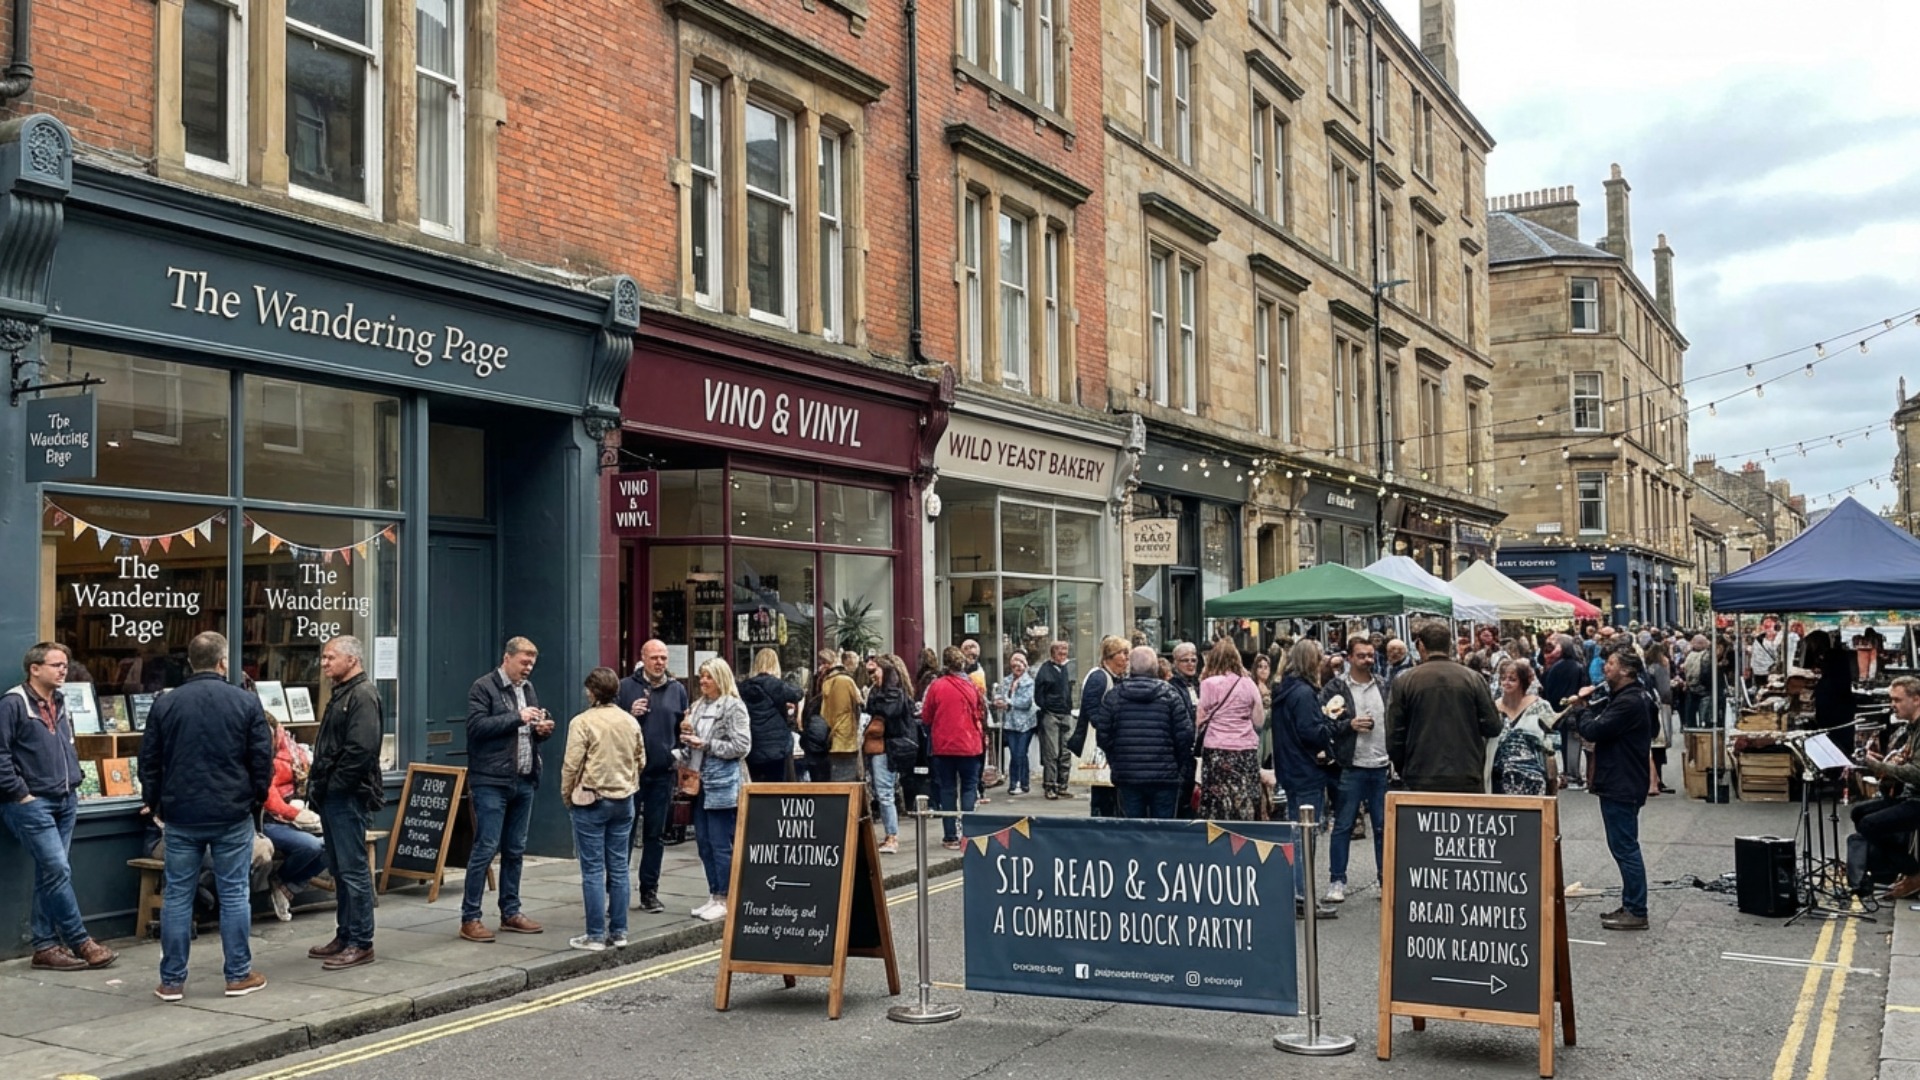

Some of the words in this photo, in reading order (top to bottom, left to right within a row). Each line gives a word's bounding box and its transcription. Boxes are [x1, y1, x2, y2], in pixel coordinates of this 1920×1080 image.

[167, 266, 241, 319] The
[253, 285, 436, 367] Wandering
[442, 326, 509, 378] Page
[704, 378, 765, 430] VINO
[771, 393, 790, 436] &
[799, 398, 862, 448] VINYL
[948, 431, 992, 463] WILD
[997, 442, 1046, 472] YEAST
[1048, 451, 1105, 483] BAKERY
[619, 479, 649, 496] VINO
[615, 511, 652, 527] VINYL
[114, 555, 160, 580] The
[299, 563, 338, 584] The
[72, 583, 200, 615] Wandering
[265, 588, 369, 617] Wandering
[109, 614, 164, 644] Page
[297, 616, 340, 643] Page
[781, 798, 815, 818] VINO
[1417, 811, 1461, 833] WILD
[1467, 813, 1517, 836] YEAST
[749, 844, 780, 864] WINE
[783, 845, 840, 867] TASTINGS
[1435, 836, 1497, 859] BAKERY
[996, 854, 1044, 901] SIP,
[1054, 858, 1114, 898] READ
[1125, 859, 1146, 900] &
[1157, 861, 1260, 906] SAVOUR
[1409, 867, 1449, 890] WINE
[1454, 869, 1528, 895] TASTINGS
[993, 905, 1005, 934] A
[1013, 906, 1111, 941] COMBINED
[1119, 911, 1180, 947] BLOCK
[1188, 916, 1252, 951] PARTY!
[1460, 903, 1527, 930] SAMPLES
[1407, 935, 1447, 960] BOOK
[1452, 938, 1529, 968] READINGS
